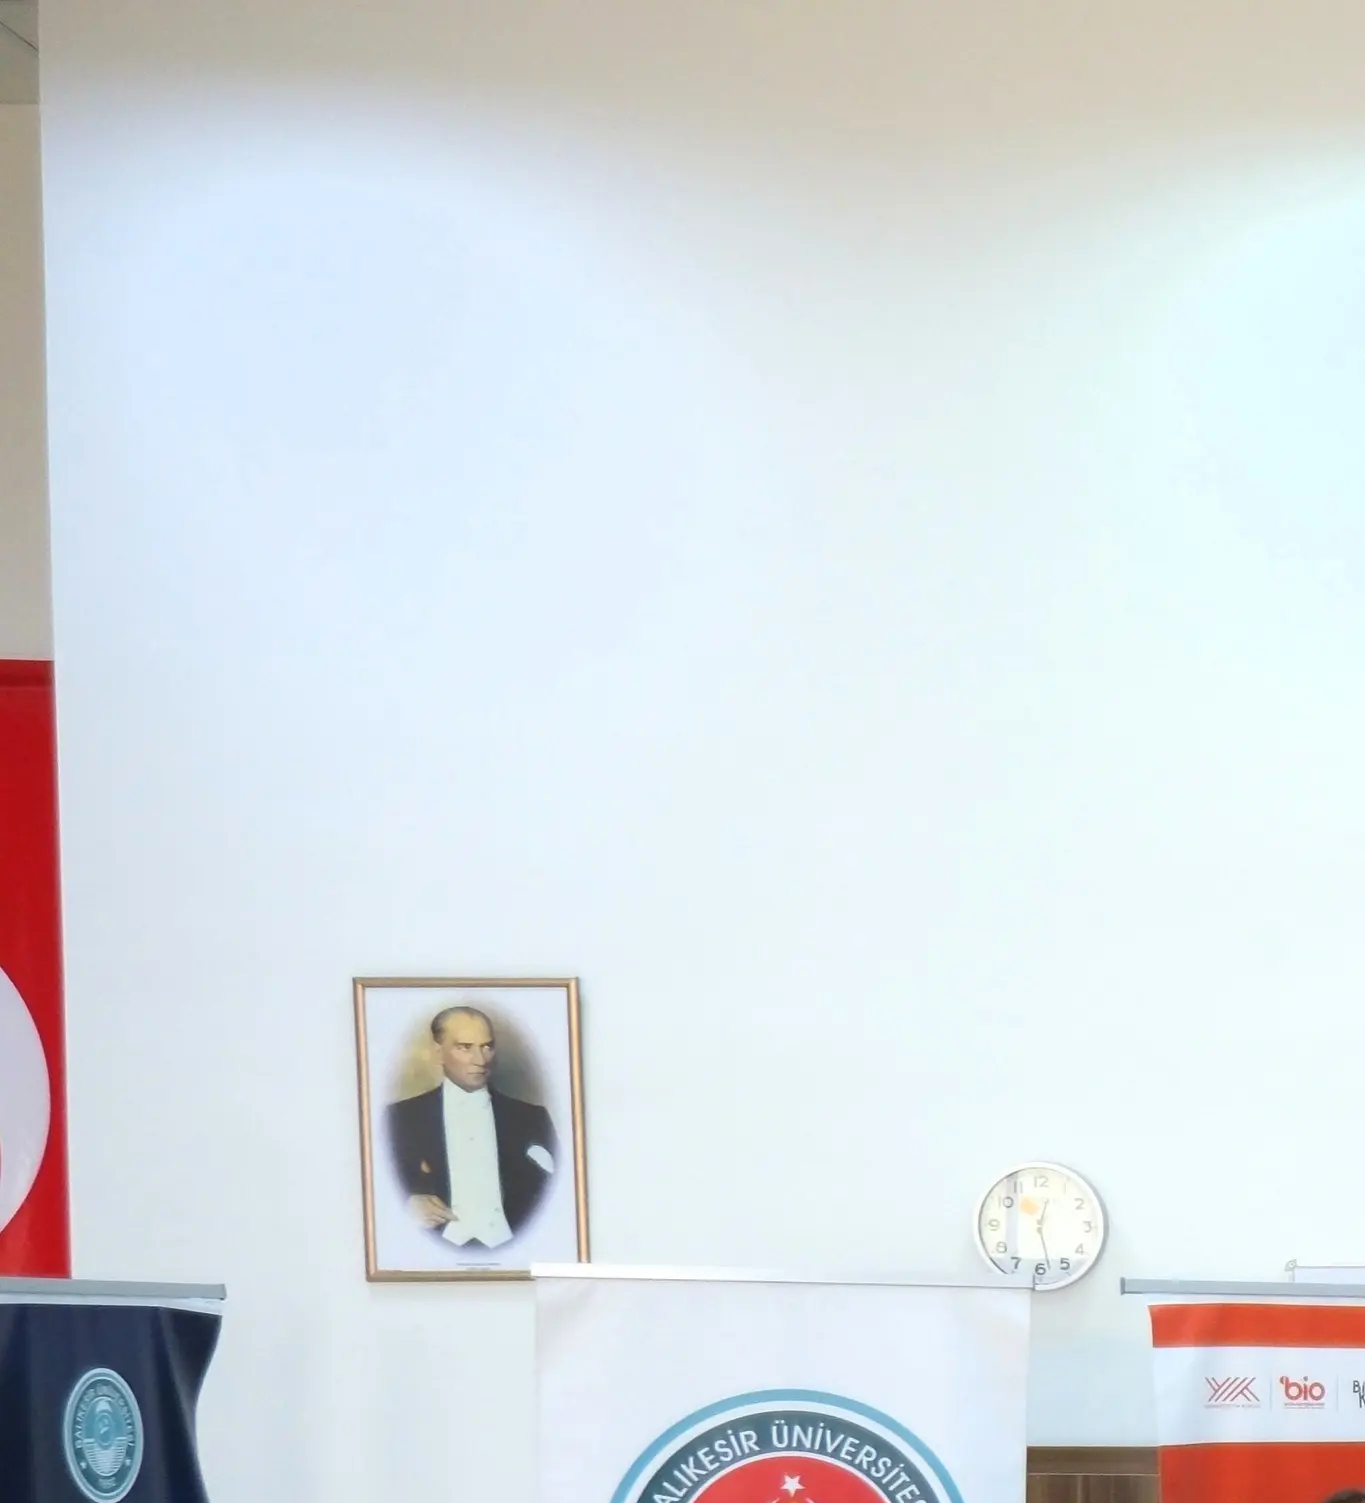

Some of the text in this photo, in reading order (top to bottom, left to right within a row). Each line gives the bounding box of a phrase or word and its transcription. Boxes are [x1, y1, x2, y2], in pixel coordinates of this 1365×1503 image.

[1034, 1175, 1049, 1187] 12
[1074, 1198, 1084, 1210] 2
[988, 1219, 1000, 1231] 9
[1083, 1221, 1093, 1233] 3
[996, 1241, 1008, 1253] 8
[1075, 1243, 1084, 1255] 4
[1011, 1257, 1021, 1269] 7
[1035, 1263, 1046, 1275] 6
[1060, 1258, 1070, 1270] 5
[1280, 1376, 1326, 1401] bio
